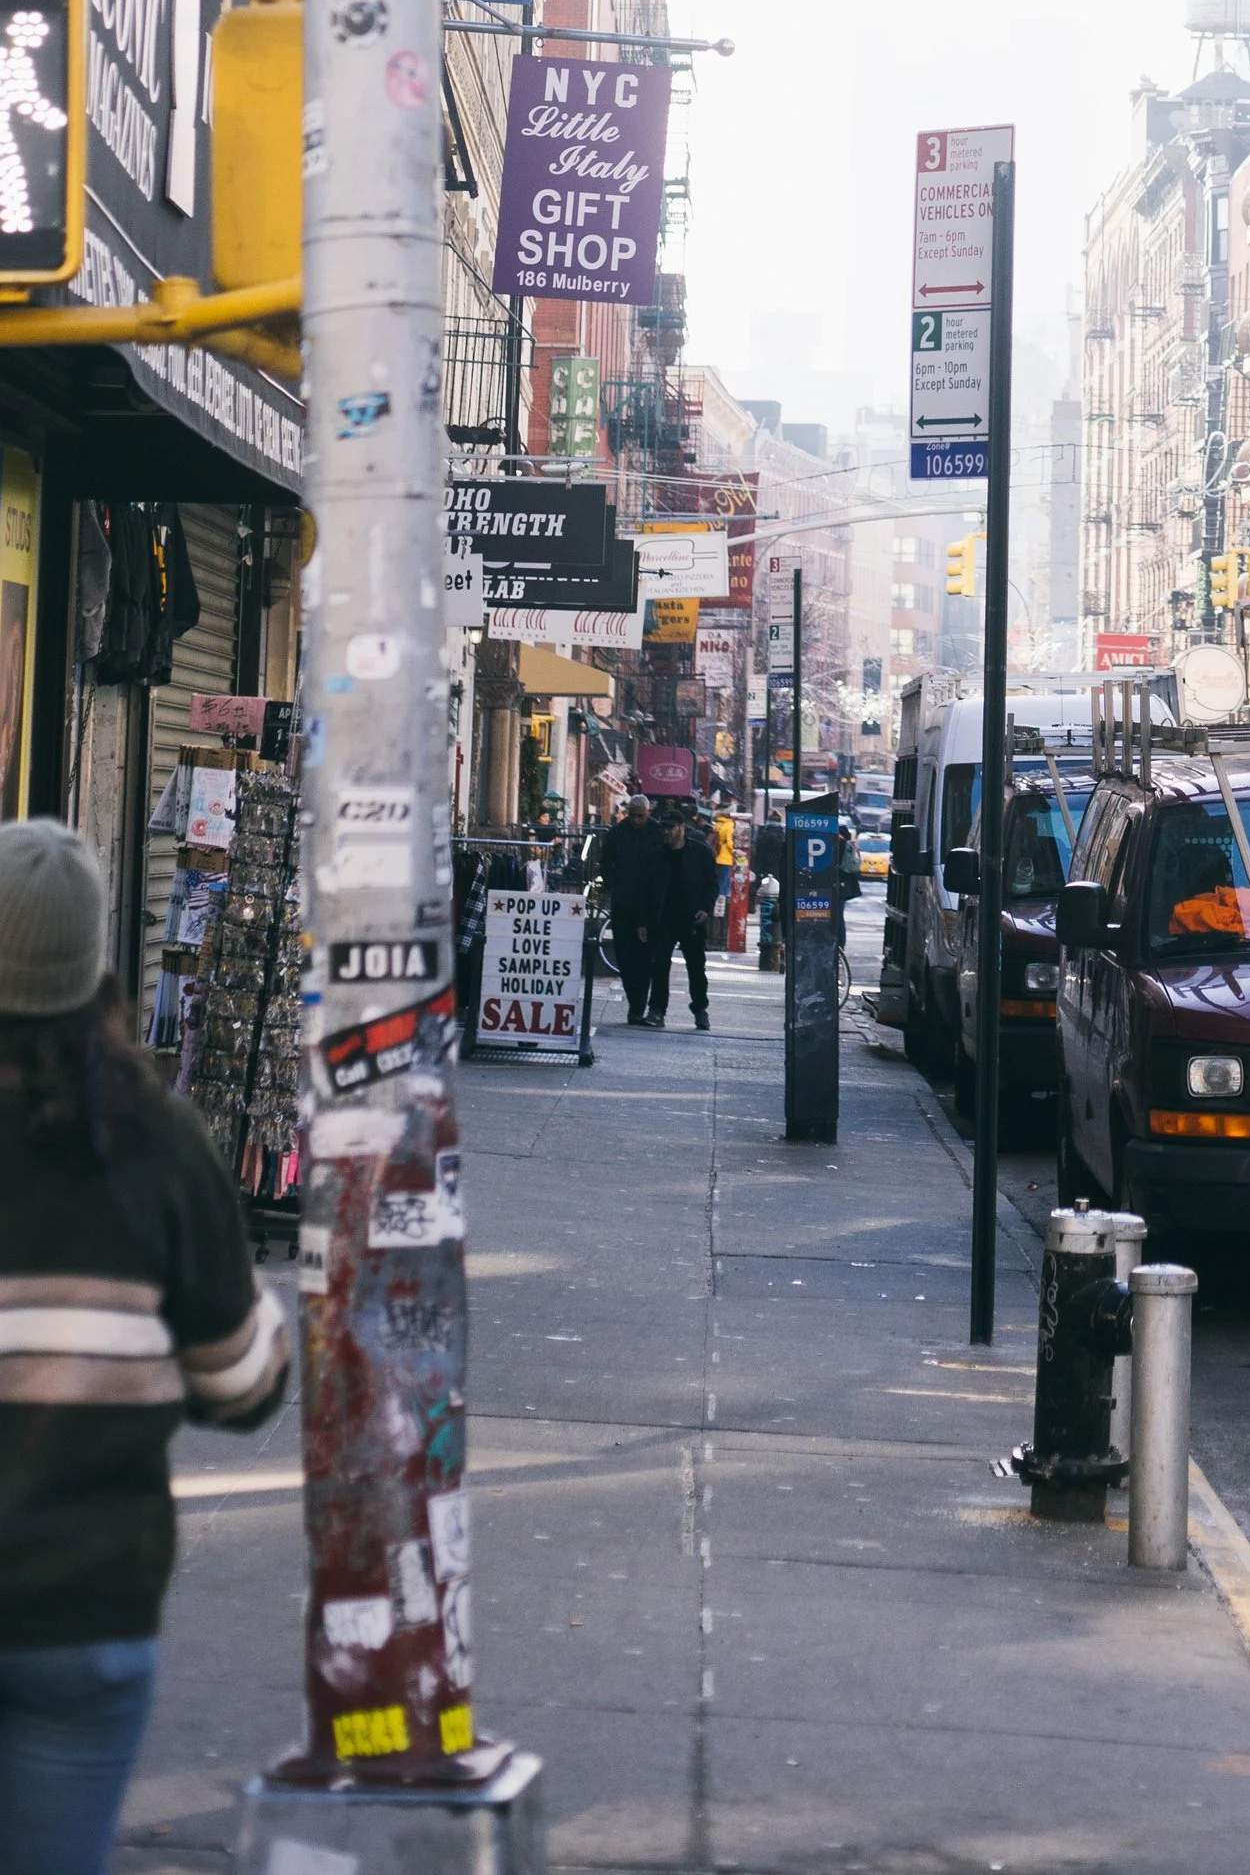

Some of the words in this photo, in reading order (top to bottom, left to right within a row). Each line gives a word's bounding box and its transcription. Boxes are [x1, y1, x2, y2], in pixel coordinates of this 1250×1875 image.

[543, 66, 639, 109] NYC
[521, 105, 621, 143] Little
[950, 136, 969, 147] hour
[924, 136, 941, 170] 3
[950, 147, 983, 159] metered
[548, 145, 650, 194] Italy
[949, 159, 978, 172] parking
[532, 188, 630, 230] GIFT
[919, 203, 975, 222] VEHICLES
[918, 230, 937, 244] 7am
[945, 229, 966, 245] 6pm
[517, 228, 637, 272] SHOP
[918, 245, 949, 262] Except
[951, 244, 985, 259] Sunday
[516, 269, 548, 288] 186
[552, 273, 631, 298] Mulberry
[945, 317, 964, 328] hour
[919, 315, 936, 349] 2
[945, 328, 978, 340] metered
[945, 340, 974, 353] parking
[915, 362, 936, 377] 6pm
[944, 361, 968, 375] 10pm
[915, 378, 946, 392] Except
[948, 376, 982, 392] Sunday
[925, 453, 985, 476] 106599
[771, 558, 778, 572] 3
[483, 579, 526, 600] LAB
[771, 627, 778, 640] 2
[1100, 652, 1145, 666] AMICI
[793, 818, 829, 828] 106599
[807, 838, 826, 868] P
[506, 898, 536, 915] POP
[541, 900, 561, 916] UP
[796, 900, 830, 910] 106599
[512, 917, 552, 936] SALE
[512, 938, 551, 956] LOVE
[338, 944, 426, 979] JOIA
[498, 957, 571, 976] SAMPLES
[501, 977, 565, 996] HOLIDAY
[481, 997, 576, 1037] SALE
